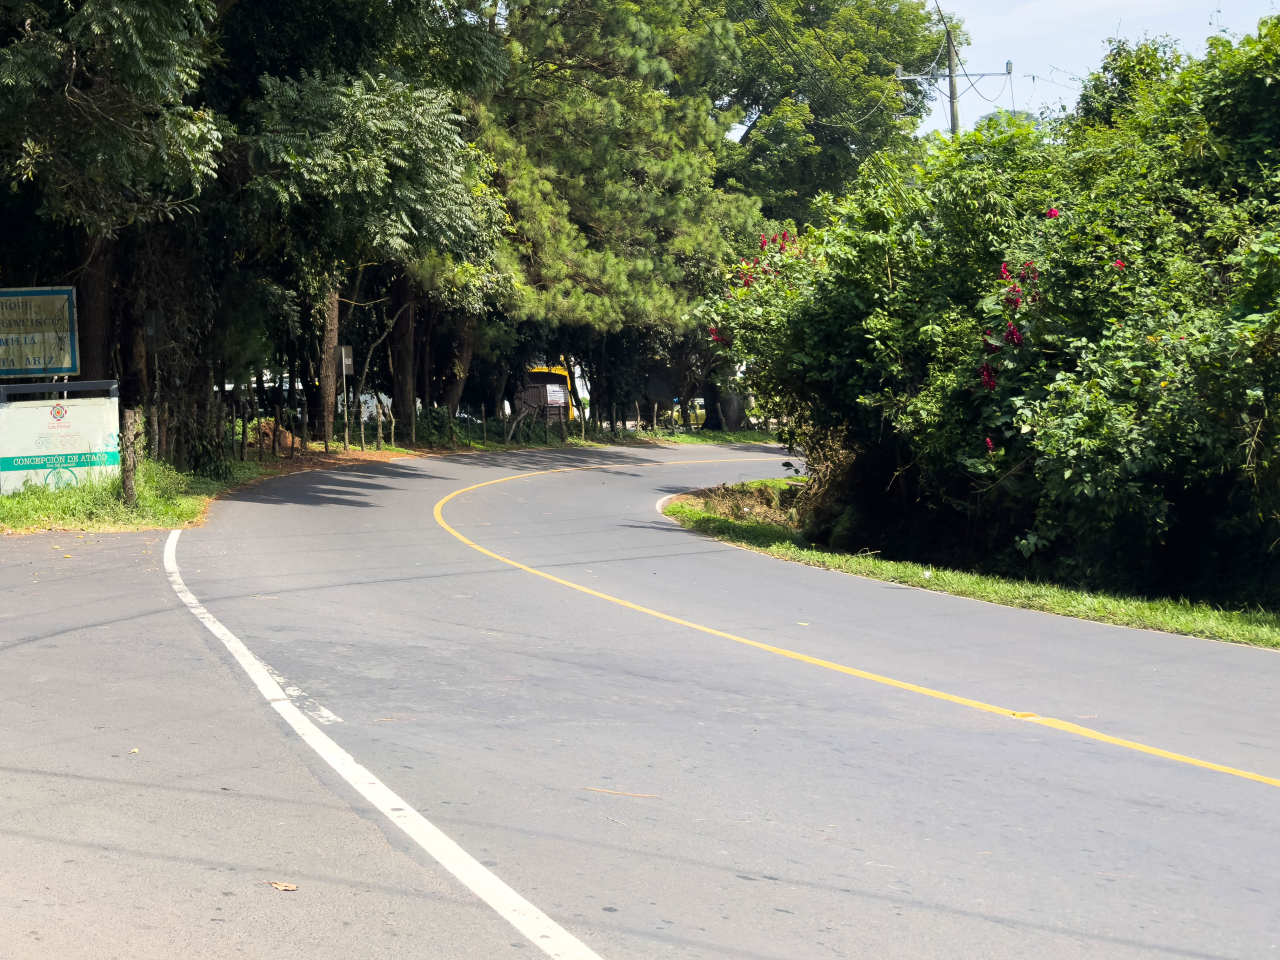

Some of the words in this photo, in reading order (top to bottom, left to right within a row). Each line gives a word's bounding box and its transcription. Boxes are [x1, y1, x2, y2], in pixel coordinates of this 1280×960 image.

[13, 454, 65, 465] CONCEPCIÓN
[67, 455, 79, 463] DE
[80, 453, 108, 462] ATACO
